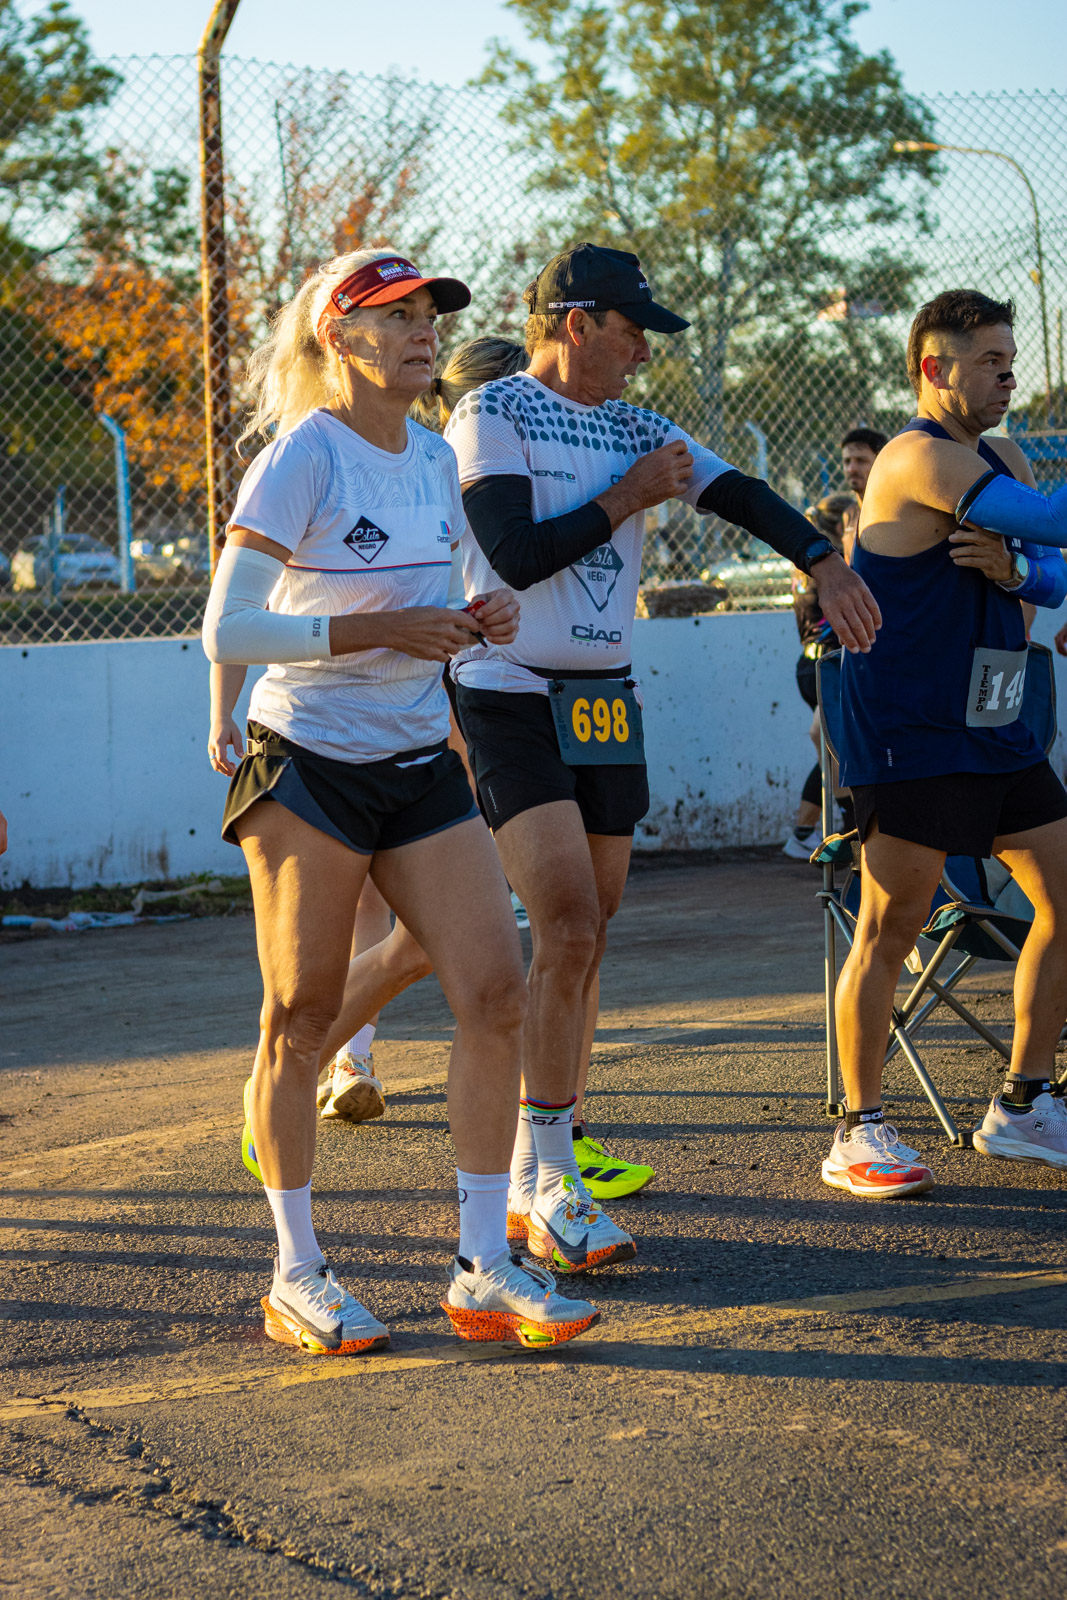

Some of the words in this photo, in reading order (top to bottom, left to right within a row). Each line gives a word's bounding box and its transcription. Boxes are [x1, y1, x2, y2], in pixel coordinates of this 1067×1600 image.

[312, 617, 322, 637] SOX
[976, 665, 991, 712] TIEMPO
[572, 697, 629, 743] 698
